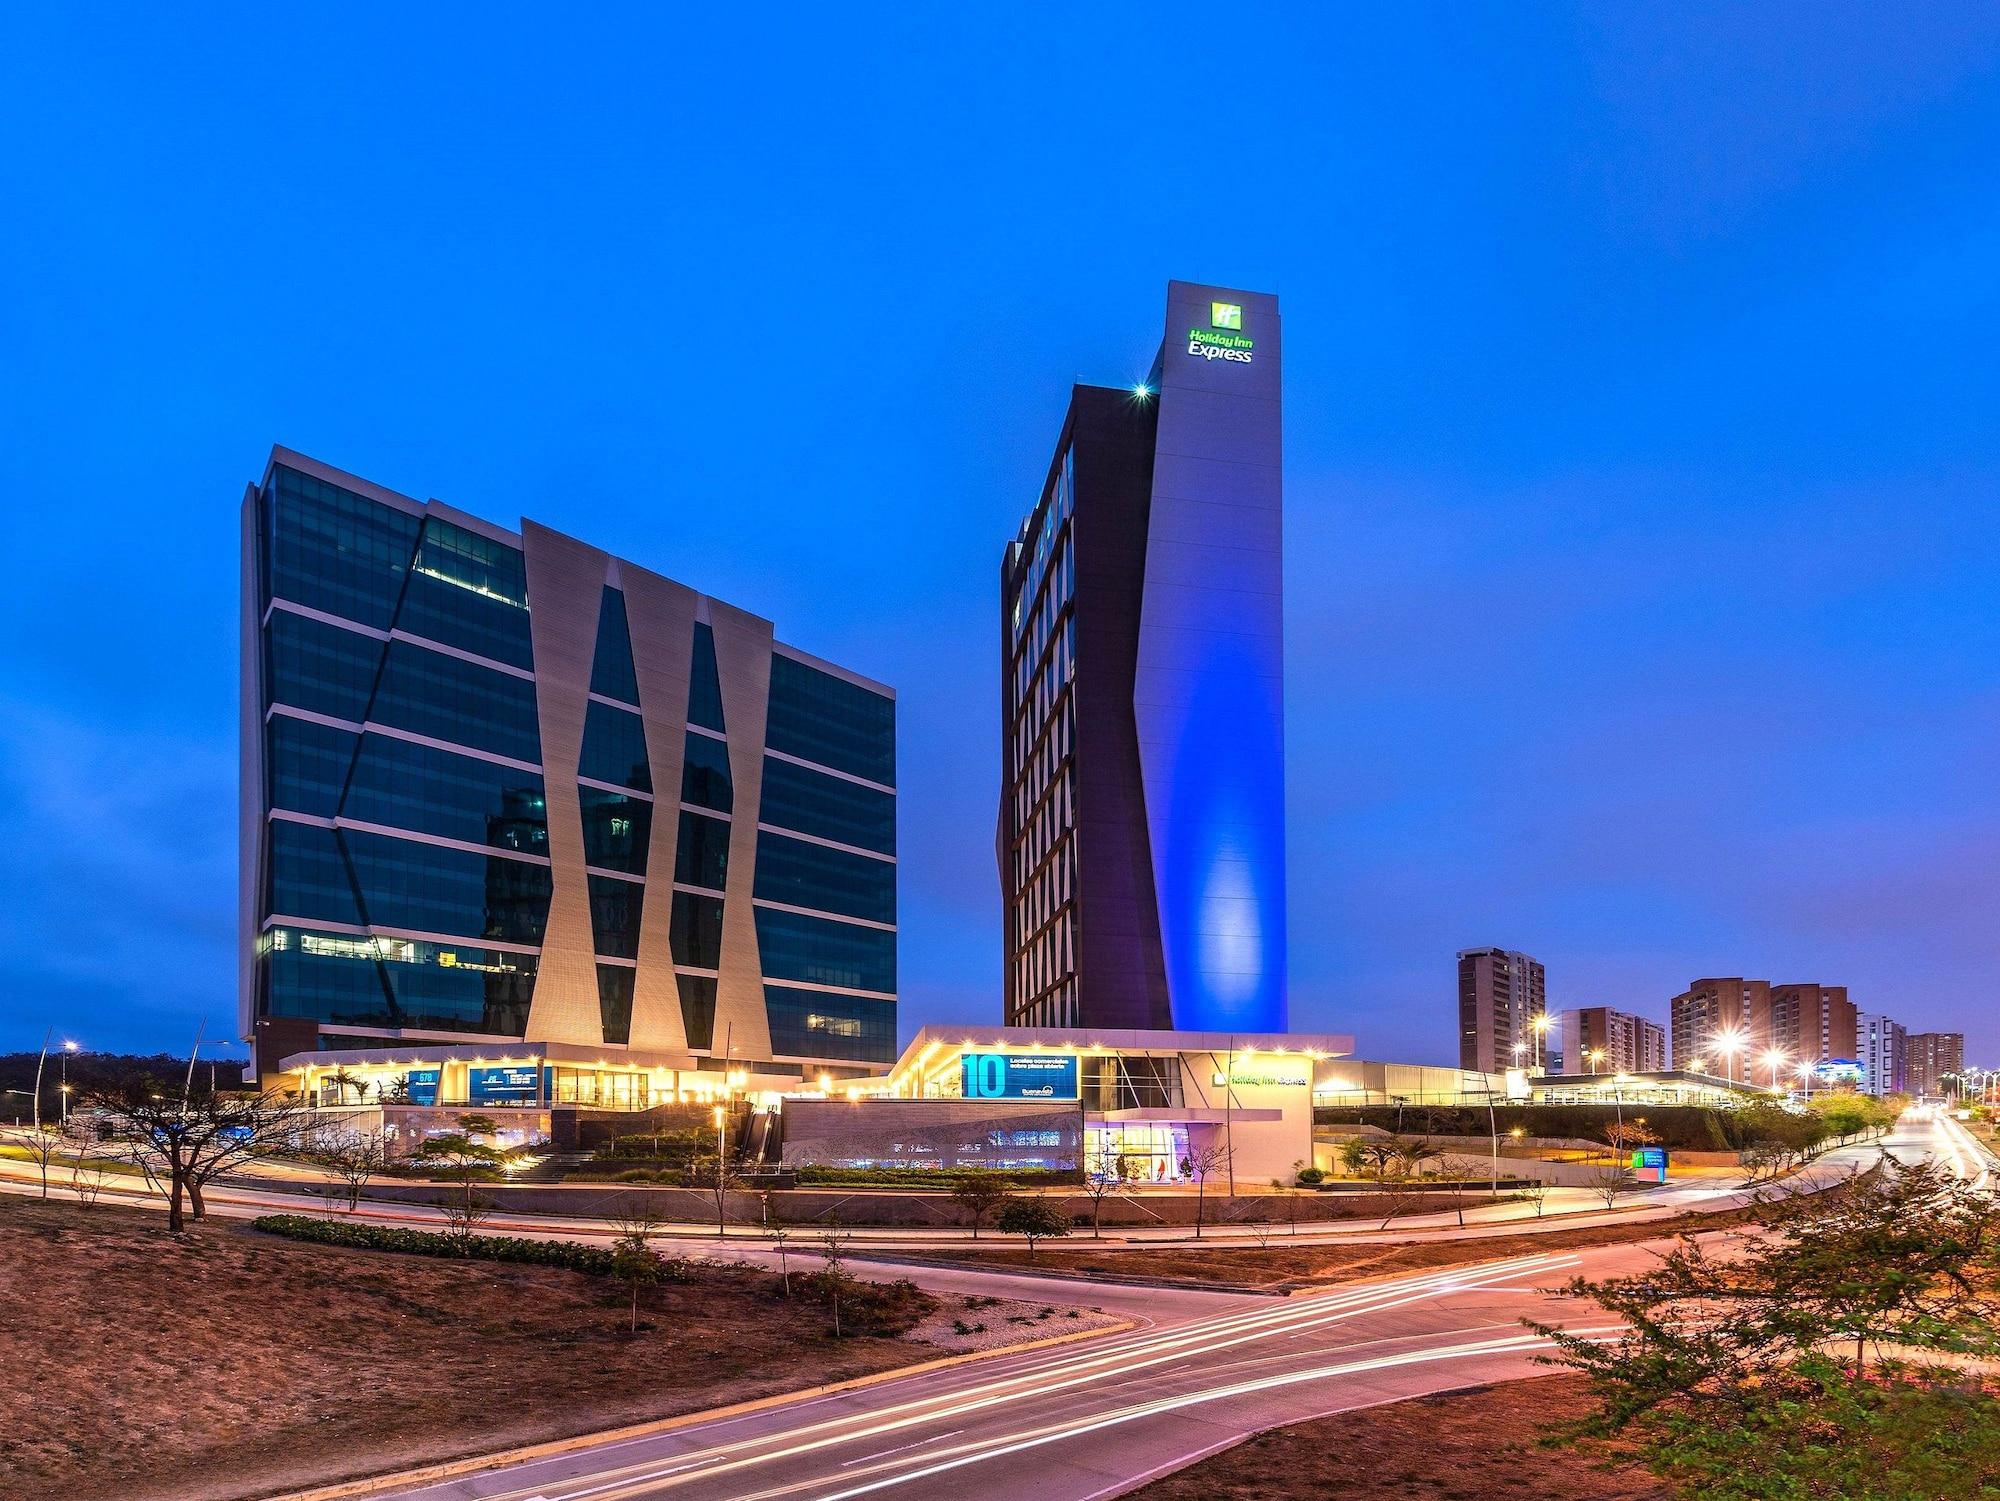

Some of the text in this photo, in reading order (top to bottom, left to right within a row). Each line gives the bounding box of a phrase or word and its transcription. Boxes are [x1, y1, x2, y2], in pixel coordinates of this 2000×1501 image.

[1189, 329, 1253, 348] Holiday Inn
[1188, 340, 1253, 363] Express
[962, 1054, 1005, 1098] 10
